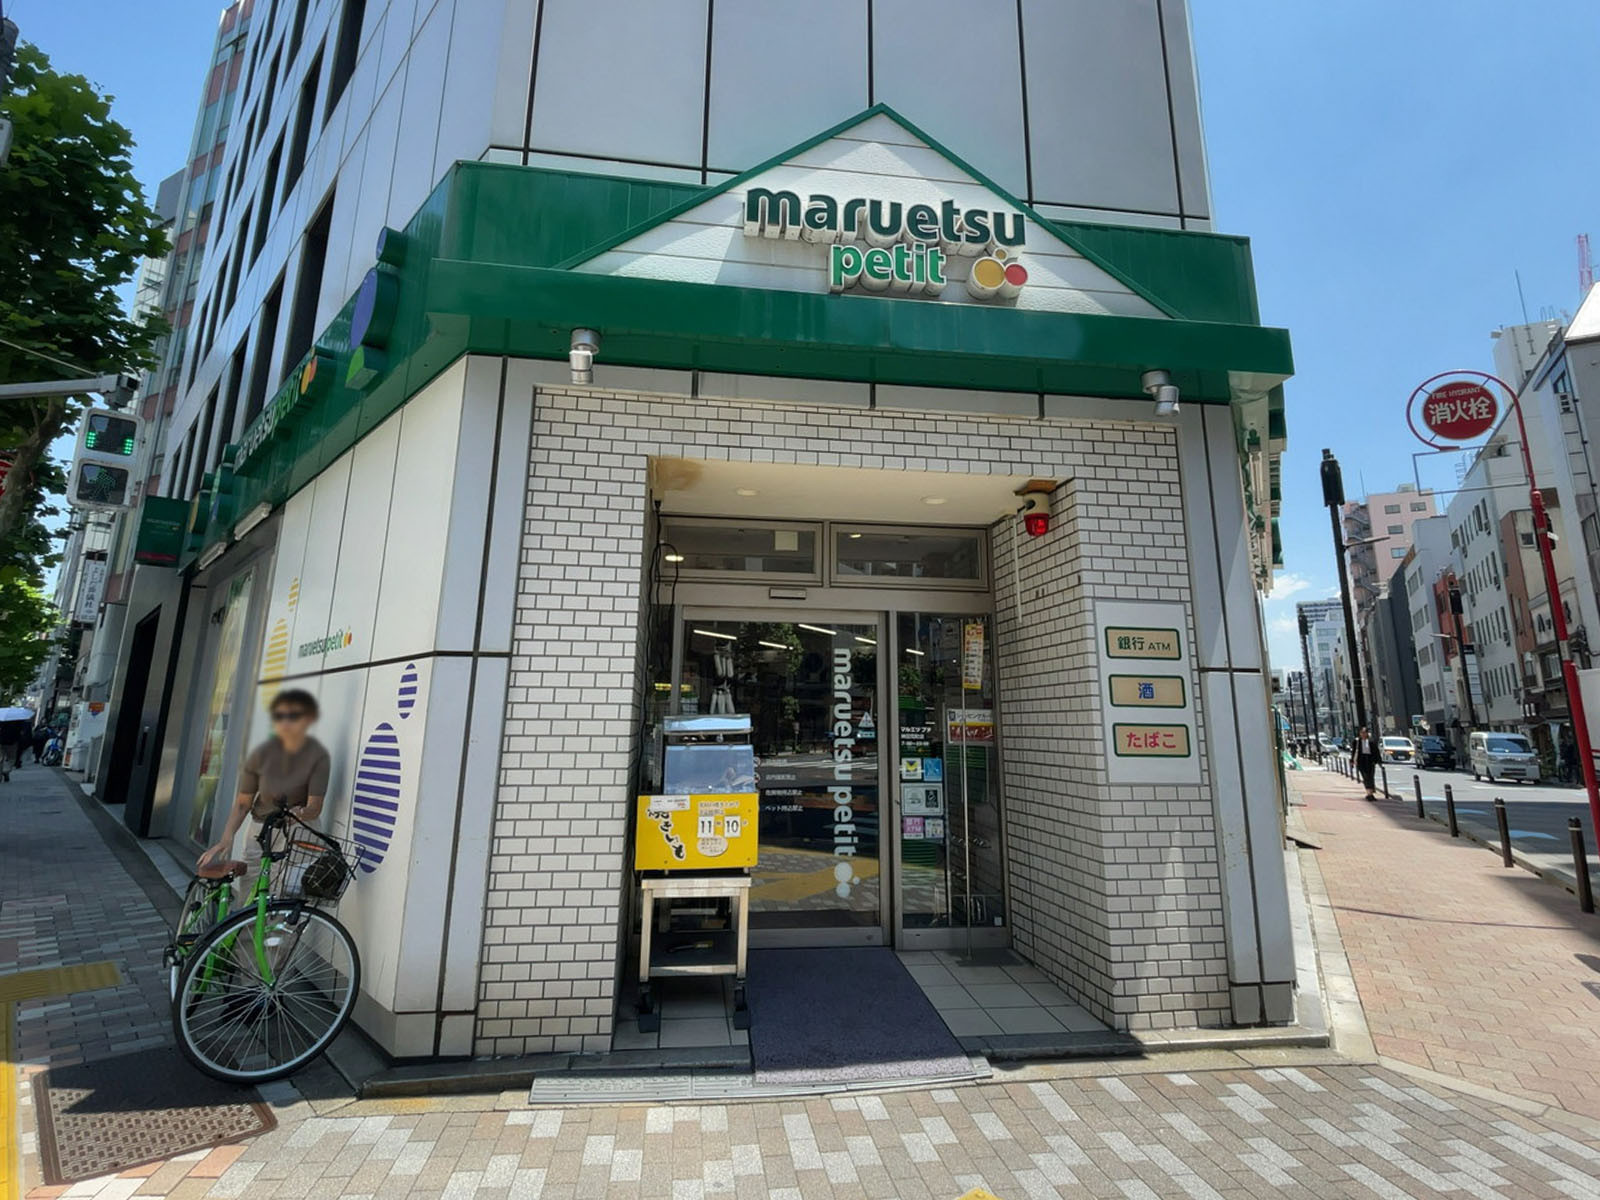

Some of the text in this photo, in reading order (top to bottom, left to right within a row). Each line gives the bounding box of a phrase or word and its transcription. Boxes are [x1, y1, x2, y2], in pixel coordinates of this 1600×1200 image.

[747, 187, 1026, 247] maruetsu
[830, 243, 947, 285] petit
[1428, 396, 1492, 425] 消火栓
[1117, 636, 1171, 651] 銀行 ATM
[1138, 682, 1154, 700] 酒
[1126, 731, 1176, 748] たばこ
[827, 648, 854, 857] maruetsu petit
[700, 820, 712, 833] 11
[726, 820, 739, 833] 10
